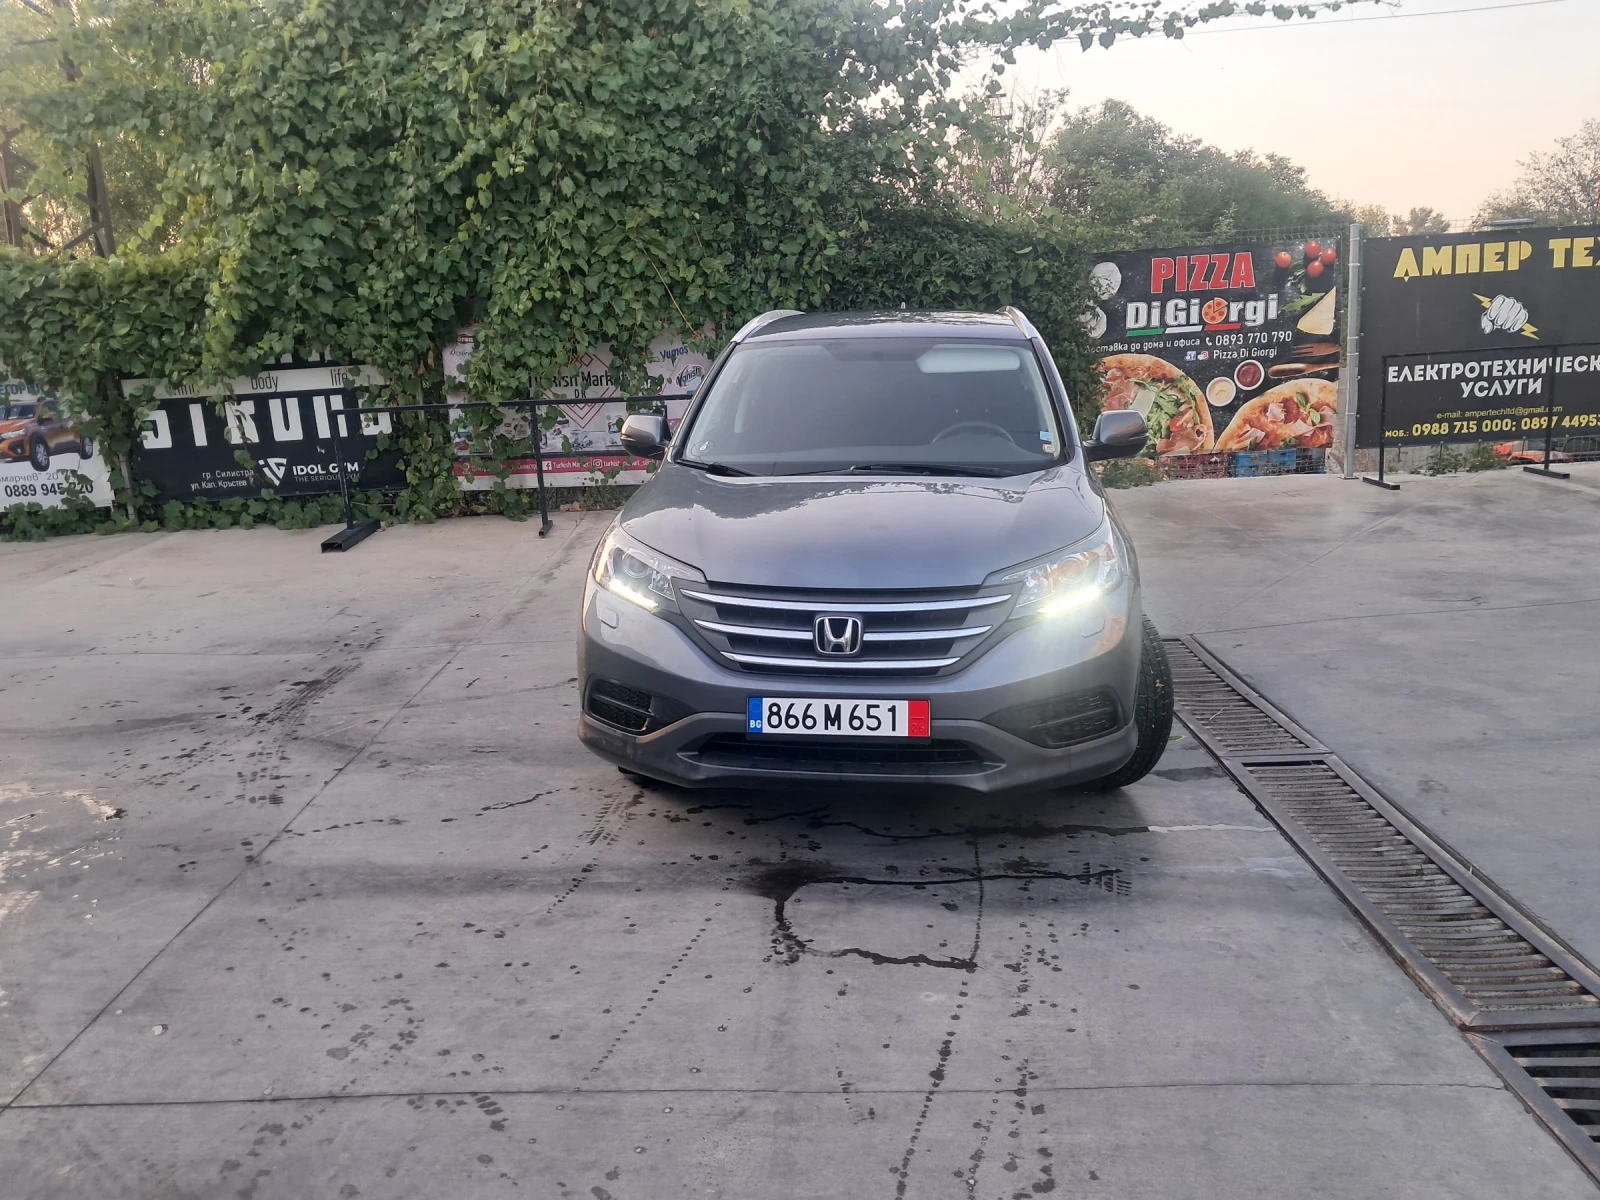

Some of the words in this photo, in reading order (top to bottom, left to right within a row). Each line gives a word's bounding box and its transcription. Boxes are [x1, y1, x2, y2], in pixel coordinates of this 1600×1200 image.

[1393, 240, 1533, 282] АМПЕР
[1548, 237, 1600, 268] ТЕ
[1151, 252, 1255, 293] PIZZA
[1173, 338, 1200, 348] офиса
[1215, 334, 1243, 346] 0893
[1247, 332, 1268, 344] 770
[1271, 331, 1292, 343] 790
[1213, 349, 1237, 360] Pizza
[1239, 348, 1249, 358] Di
[1251, 346, 1277, 358] Giorgi
[250, 372, 278, 393] body
[1460, 378, 1542, 398] УСЛУГИ
[1436, 410, 1463, 419] e-mail:
[1412, 422, 1449, 436] 0988
[1453, 421, 1477, 434] 715
[1482, 418, 1517, 432] 000;
[1521, 416, 1558, 430] 0897
[1561, 414, 1600, 428] 4495
[202, 472, 213, 480] гр.
[215, 469, 254, 478] Силистра
[292, 464, 326, 475] IDOL
[4, 484, 37, 498] 0889
[218, 480, 247, 489] Кръстев
[749, 719, 762, 728] BG
[767, 702, 817, 730] 866
[824, 703, 841, 731] M
[849, 704, 897, 732] 651
